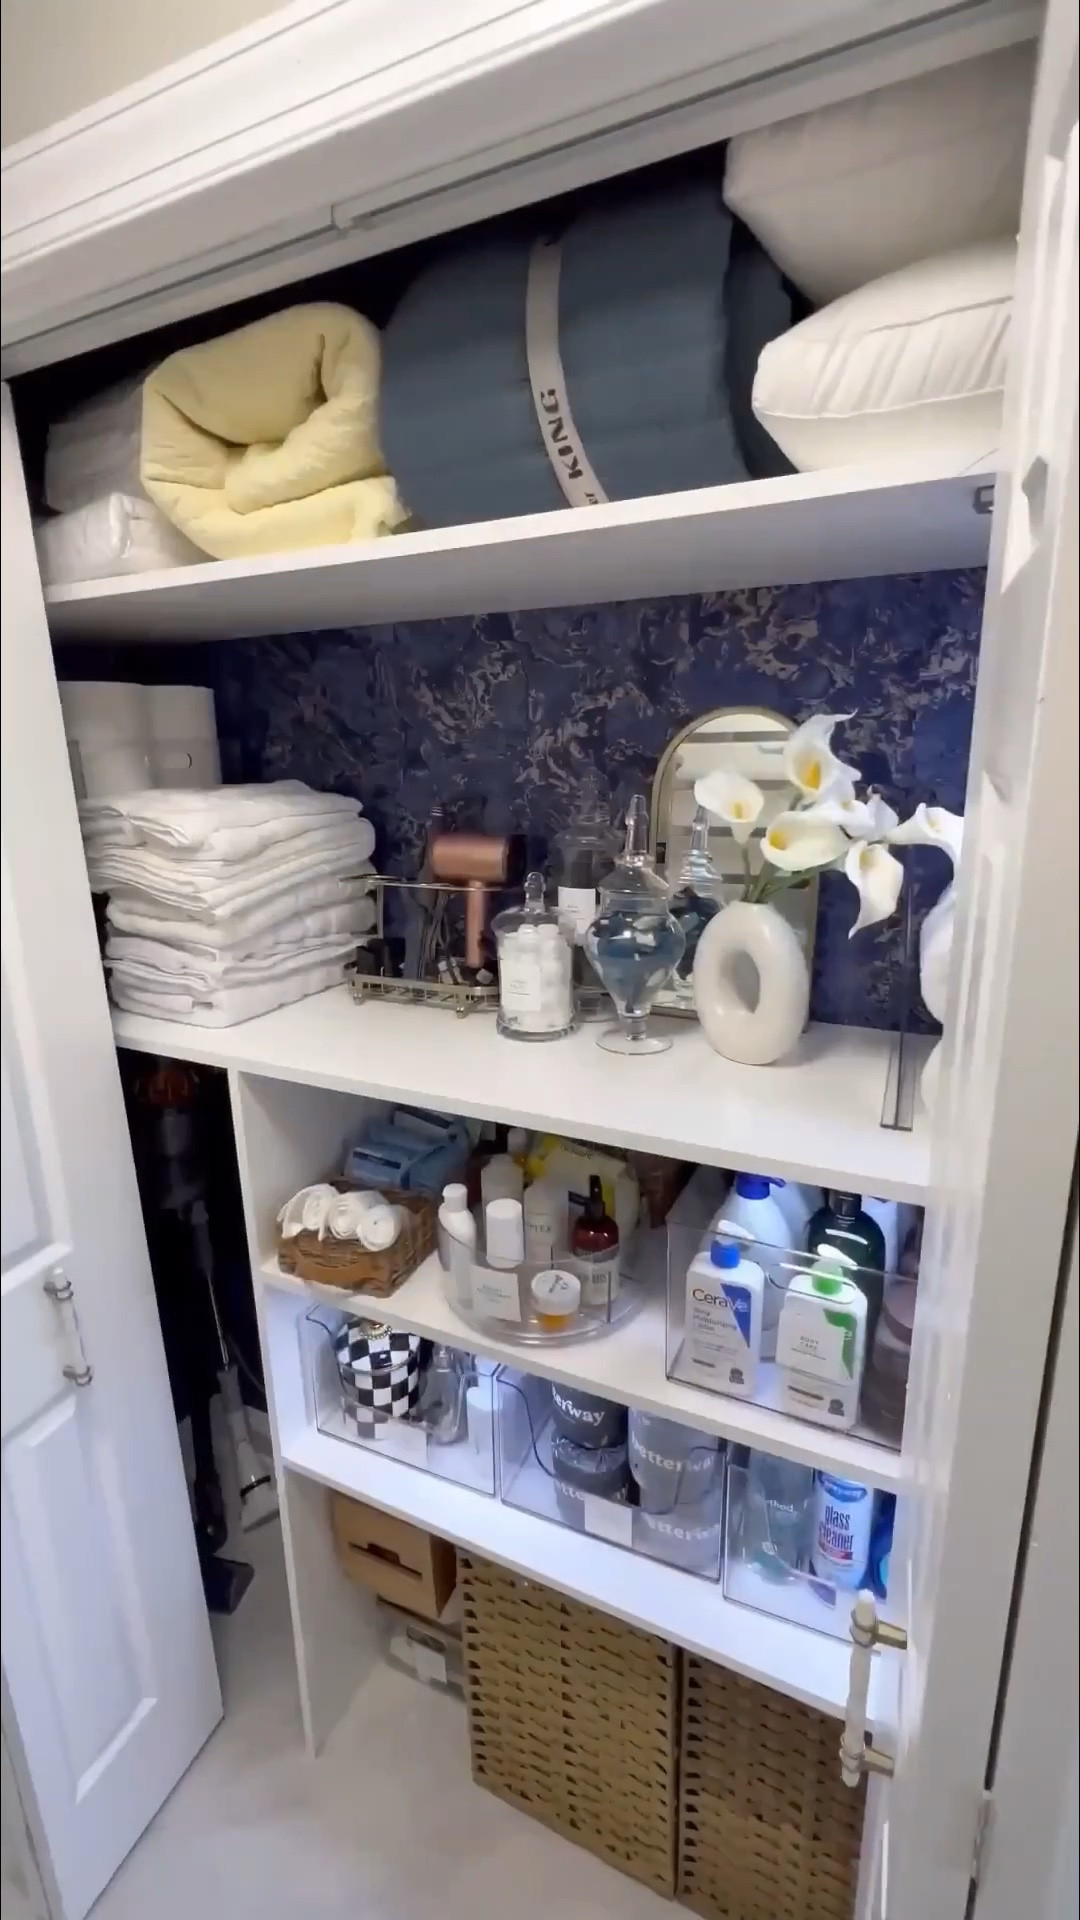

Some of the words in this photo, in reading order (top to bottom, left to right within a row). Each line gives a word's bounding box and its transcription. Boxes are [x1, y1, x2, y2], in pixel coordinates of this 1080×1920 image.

[540, 388, 584, 480] KING
[692, 1288, 749, 1313] CeraVe
[824, 1504, 851, 1531] glass
[818, 1520, 855, 1551] cleaner
